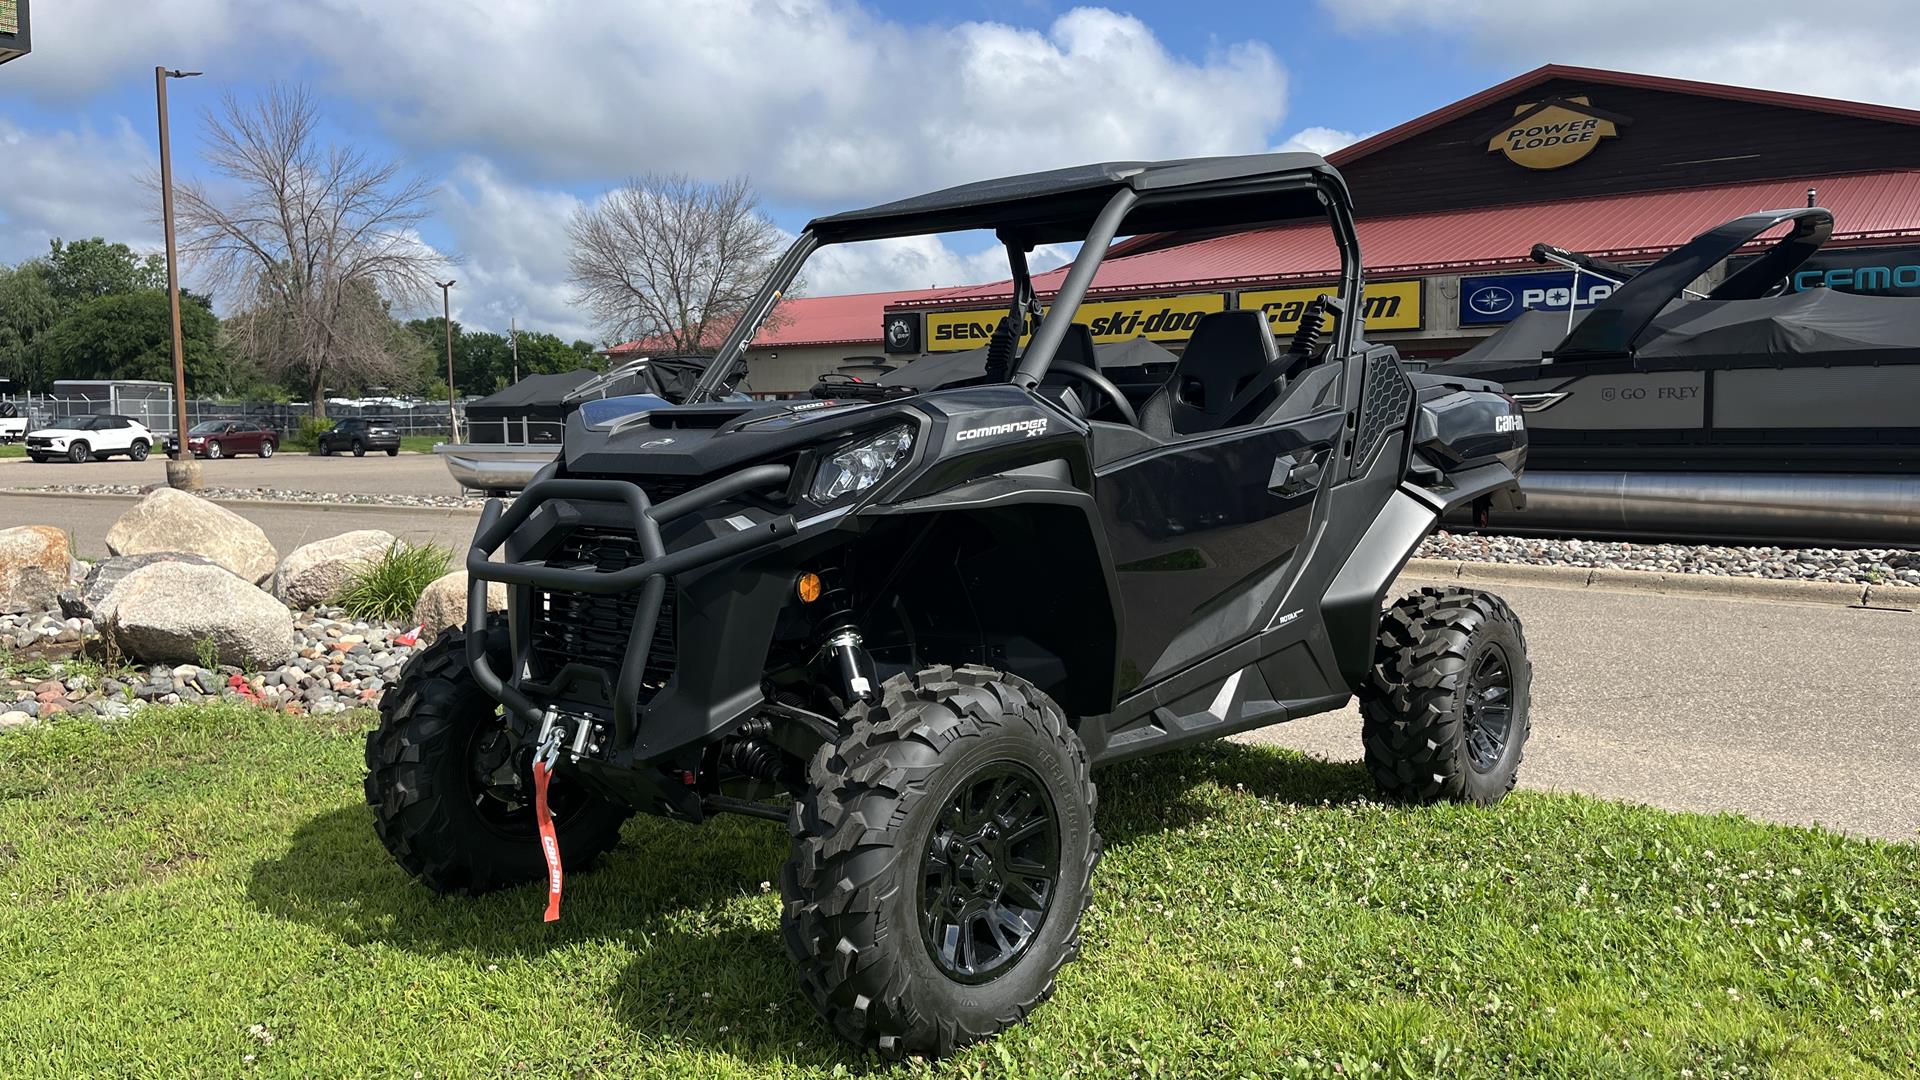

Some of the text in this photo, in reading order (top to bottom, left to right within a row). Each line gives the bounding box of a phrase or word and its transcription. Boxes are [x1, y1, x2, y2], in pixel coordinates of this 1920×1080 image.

[1507, 118, 1599, 142] POWER
[1510, 131, 1594, 151] LODGE
[1090, 308, 1206, 336] ski-doo
[956, 418, 1048, 441] COMMANDER
[1026, 427, 1047, 438] XT
